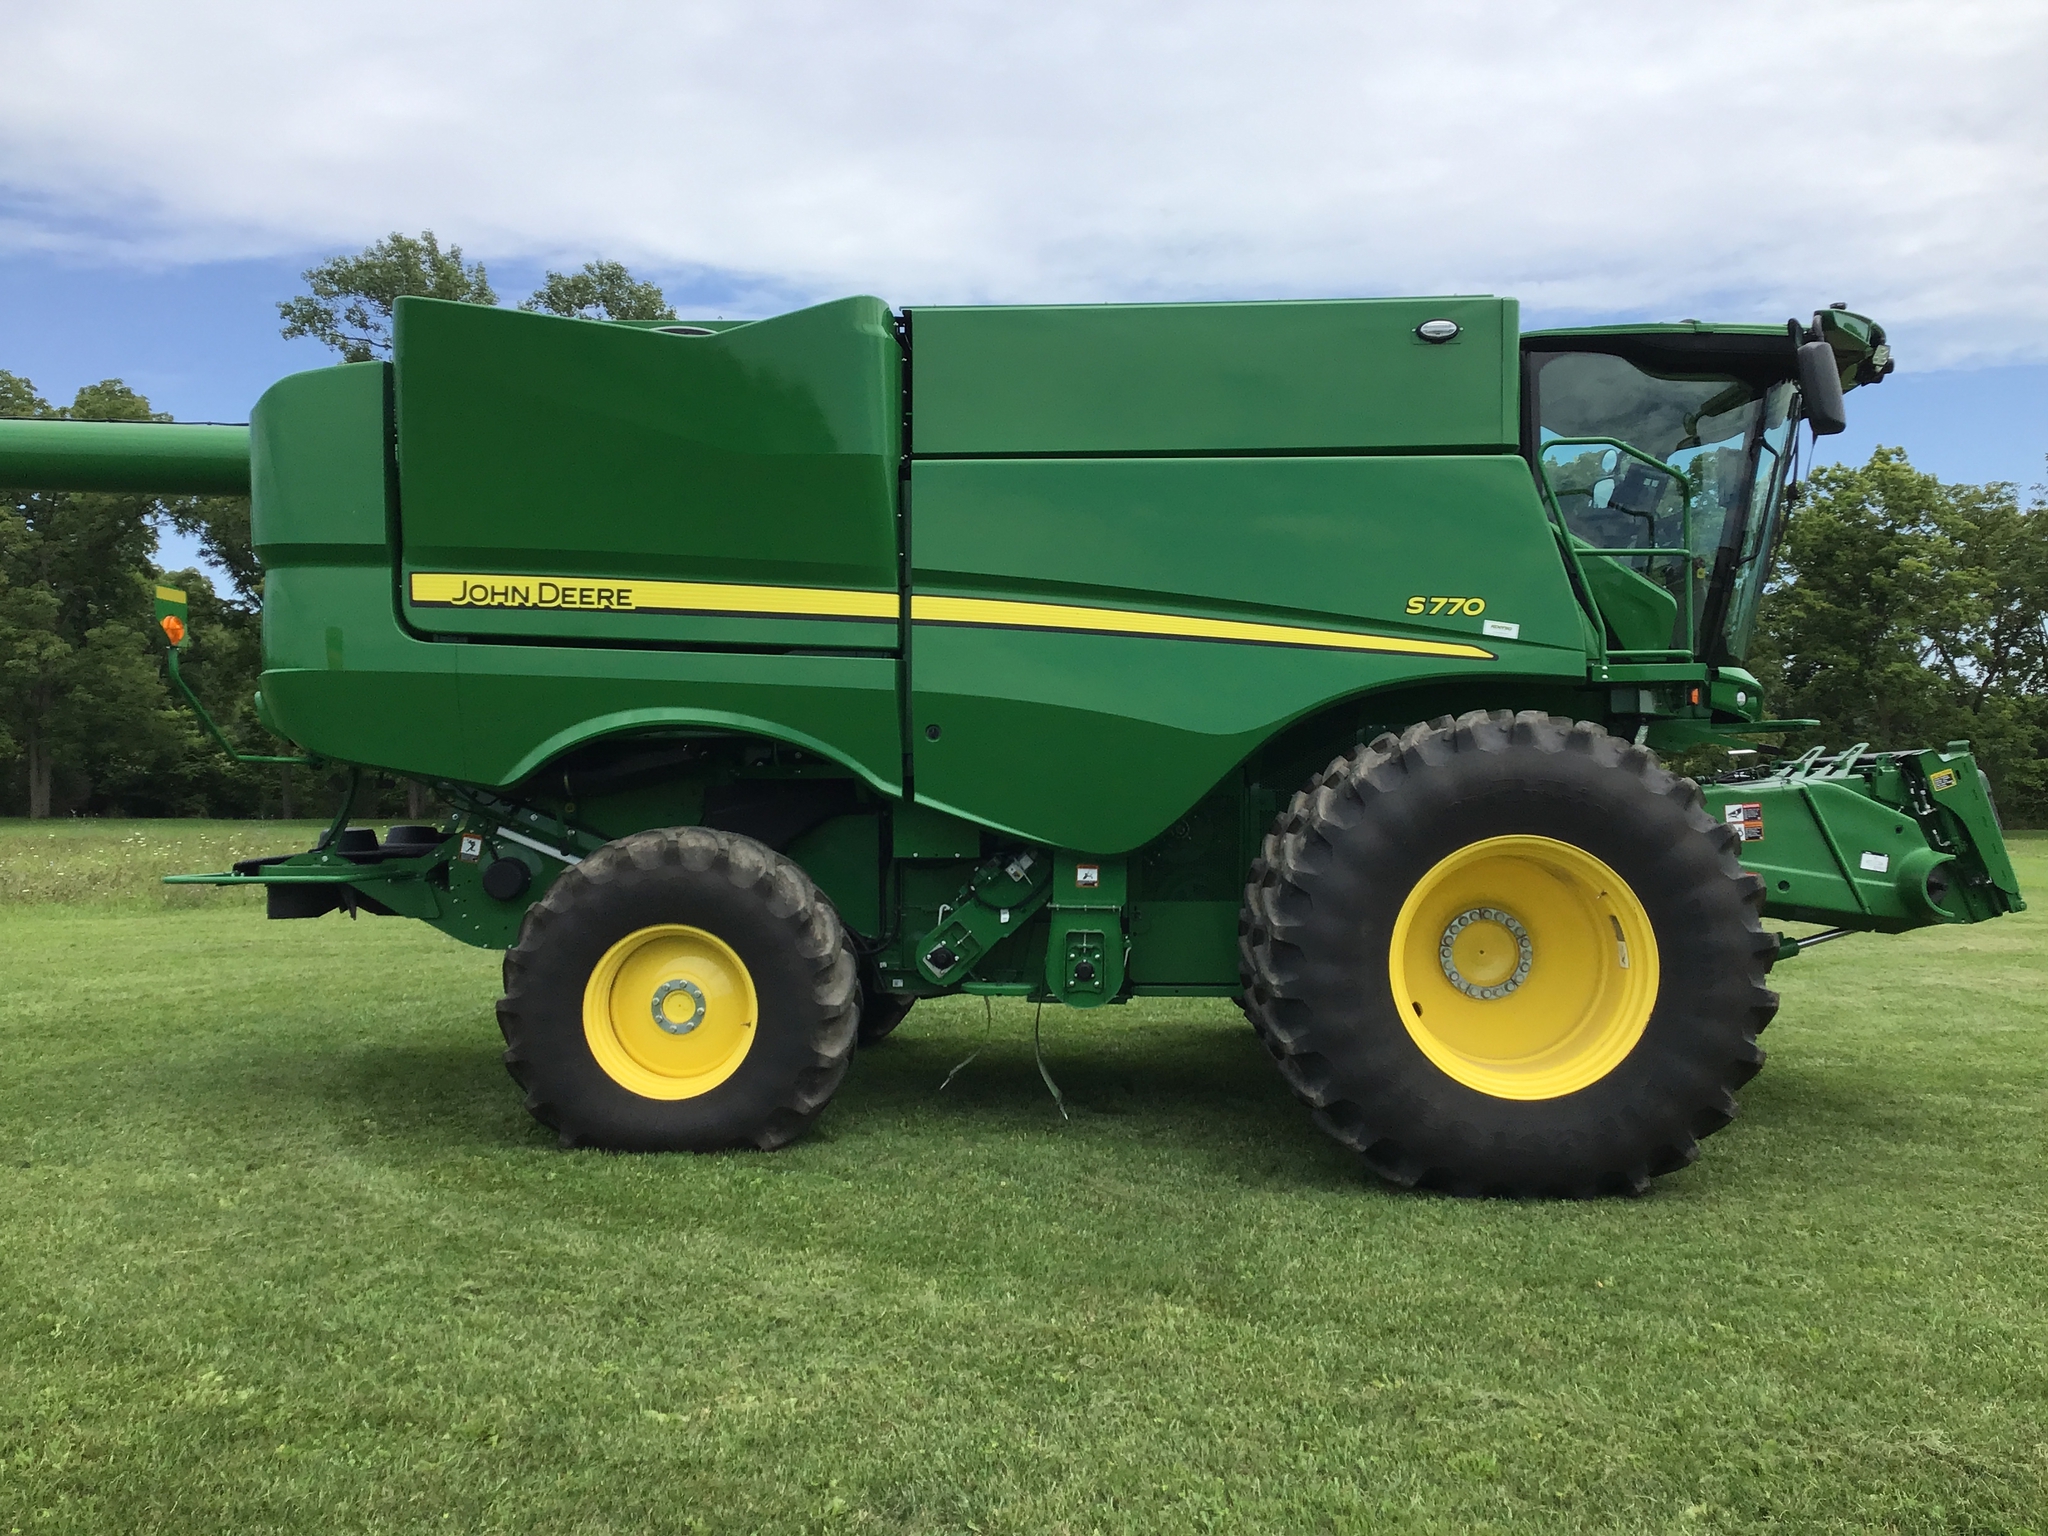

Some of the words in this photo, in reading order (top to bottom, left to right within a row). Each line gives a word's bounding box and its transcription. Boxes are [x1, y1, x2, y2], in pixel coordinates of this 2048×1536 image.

[452, 580, 530, 603] JOHN
[538, 582, 633, 607] DEERE
[1405, 596, 1486, 617] S770
